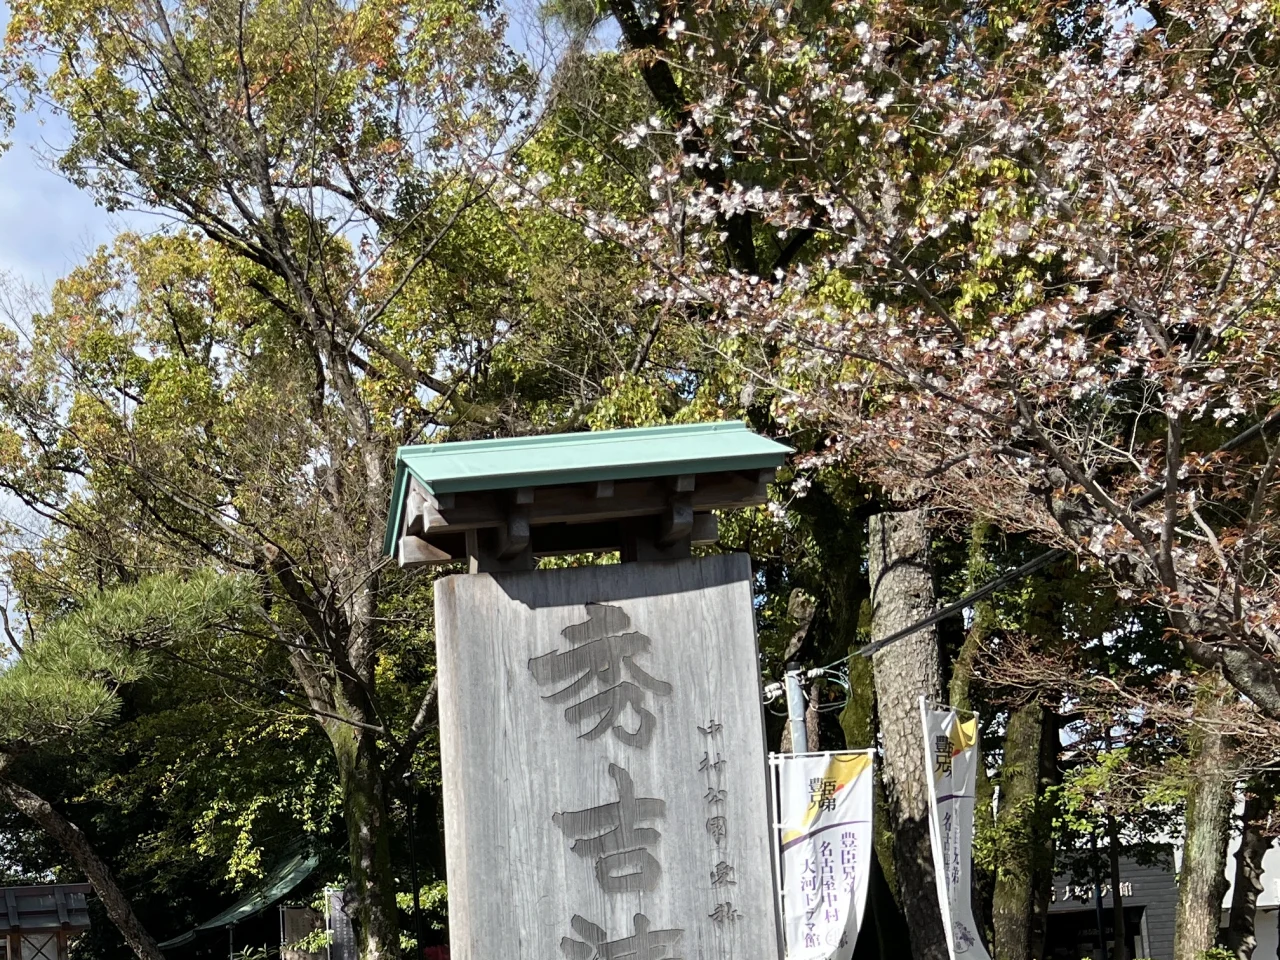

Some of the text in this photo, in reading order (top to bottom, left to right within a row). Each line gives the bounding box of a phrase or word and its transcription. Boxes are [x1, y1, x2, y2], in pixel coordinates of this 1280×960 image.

[800, 858, 820, 949] 大河ドラマ館
[819, 840, 839, 923] 名古屋中村
